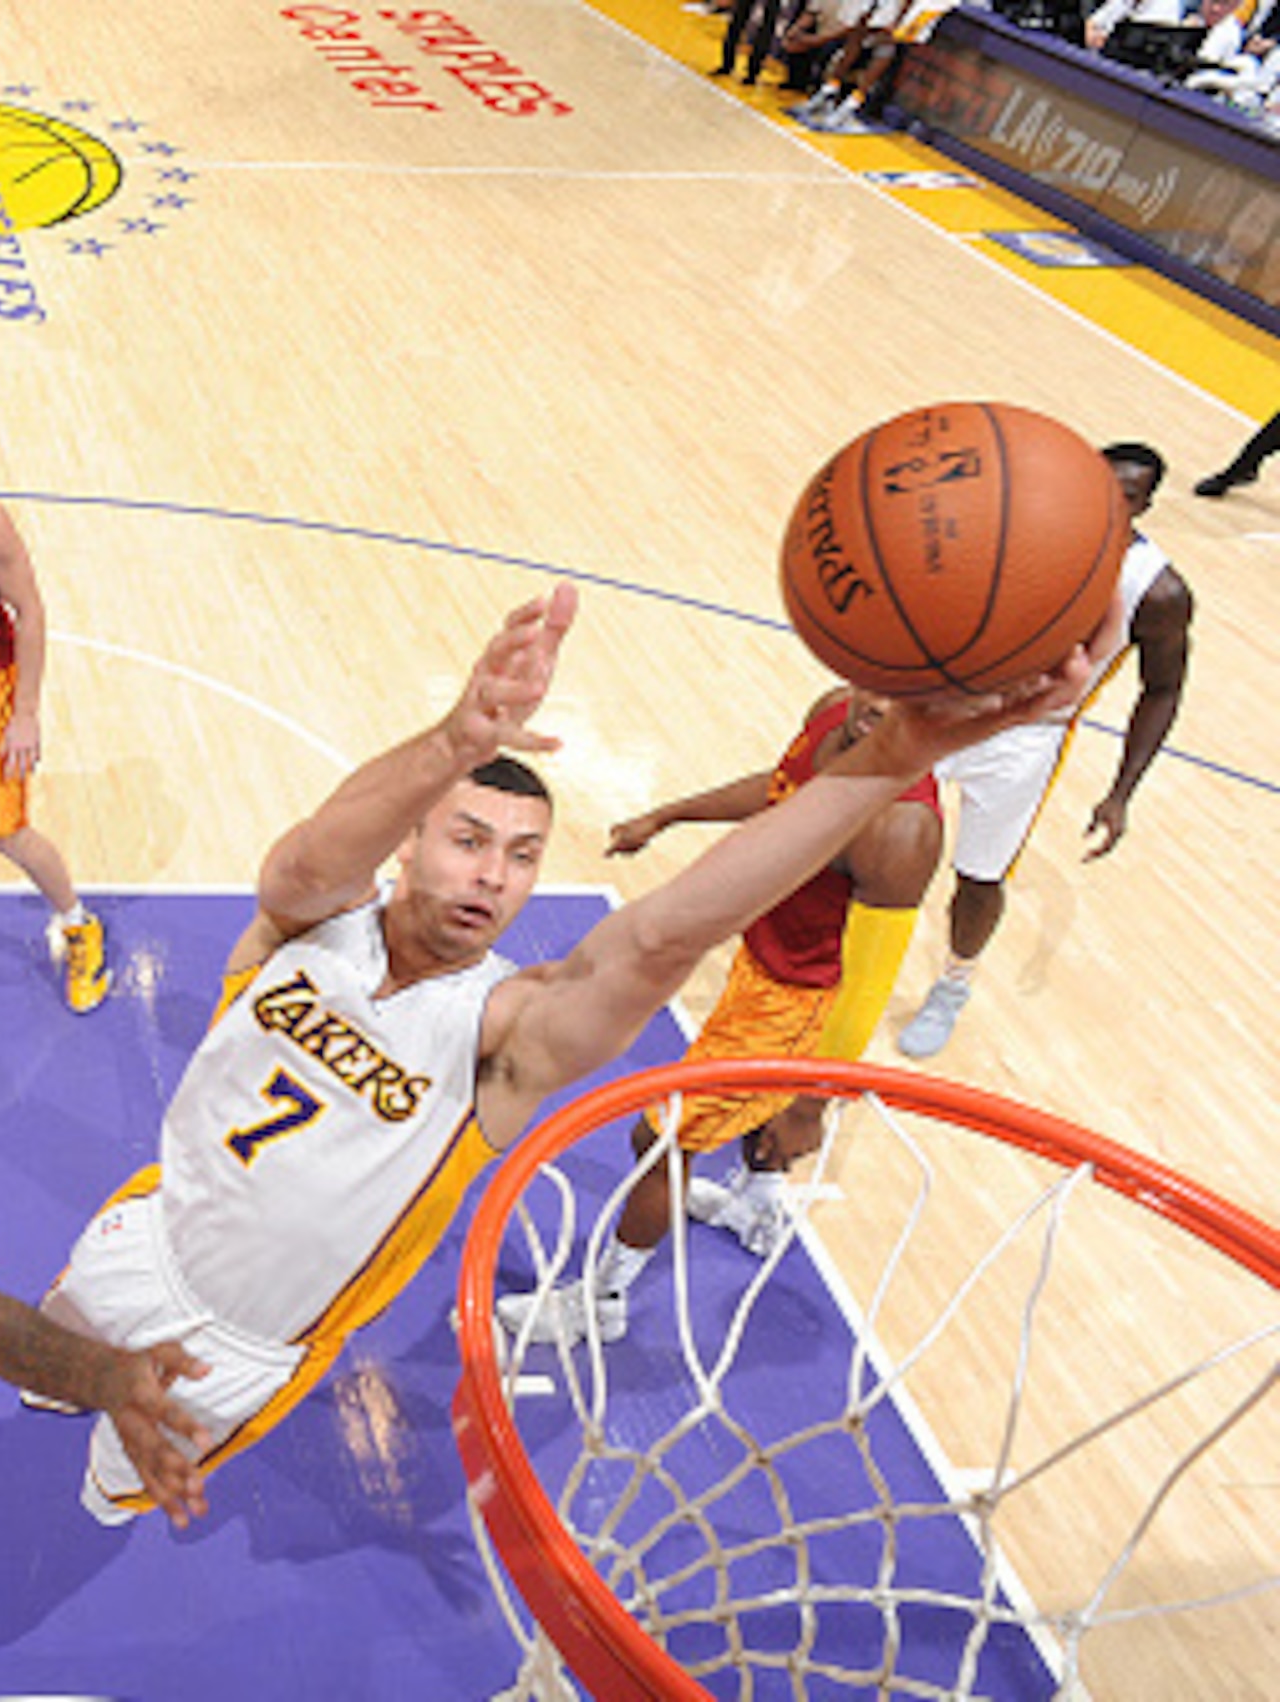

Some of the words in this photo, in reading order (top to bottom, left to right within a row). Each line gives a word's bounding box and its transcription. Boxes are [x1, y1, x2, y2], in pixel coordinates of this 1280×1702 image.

[278, 5, 444, 112] Center
[376, 9, 574, 117] STAPLES
[989, 83, 1052, 156] LA
[1053, 126, 1125, 194] 710
[252, 966, 434, 1124] LAKERS
[222, 1062, 327, 1170] 7
